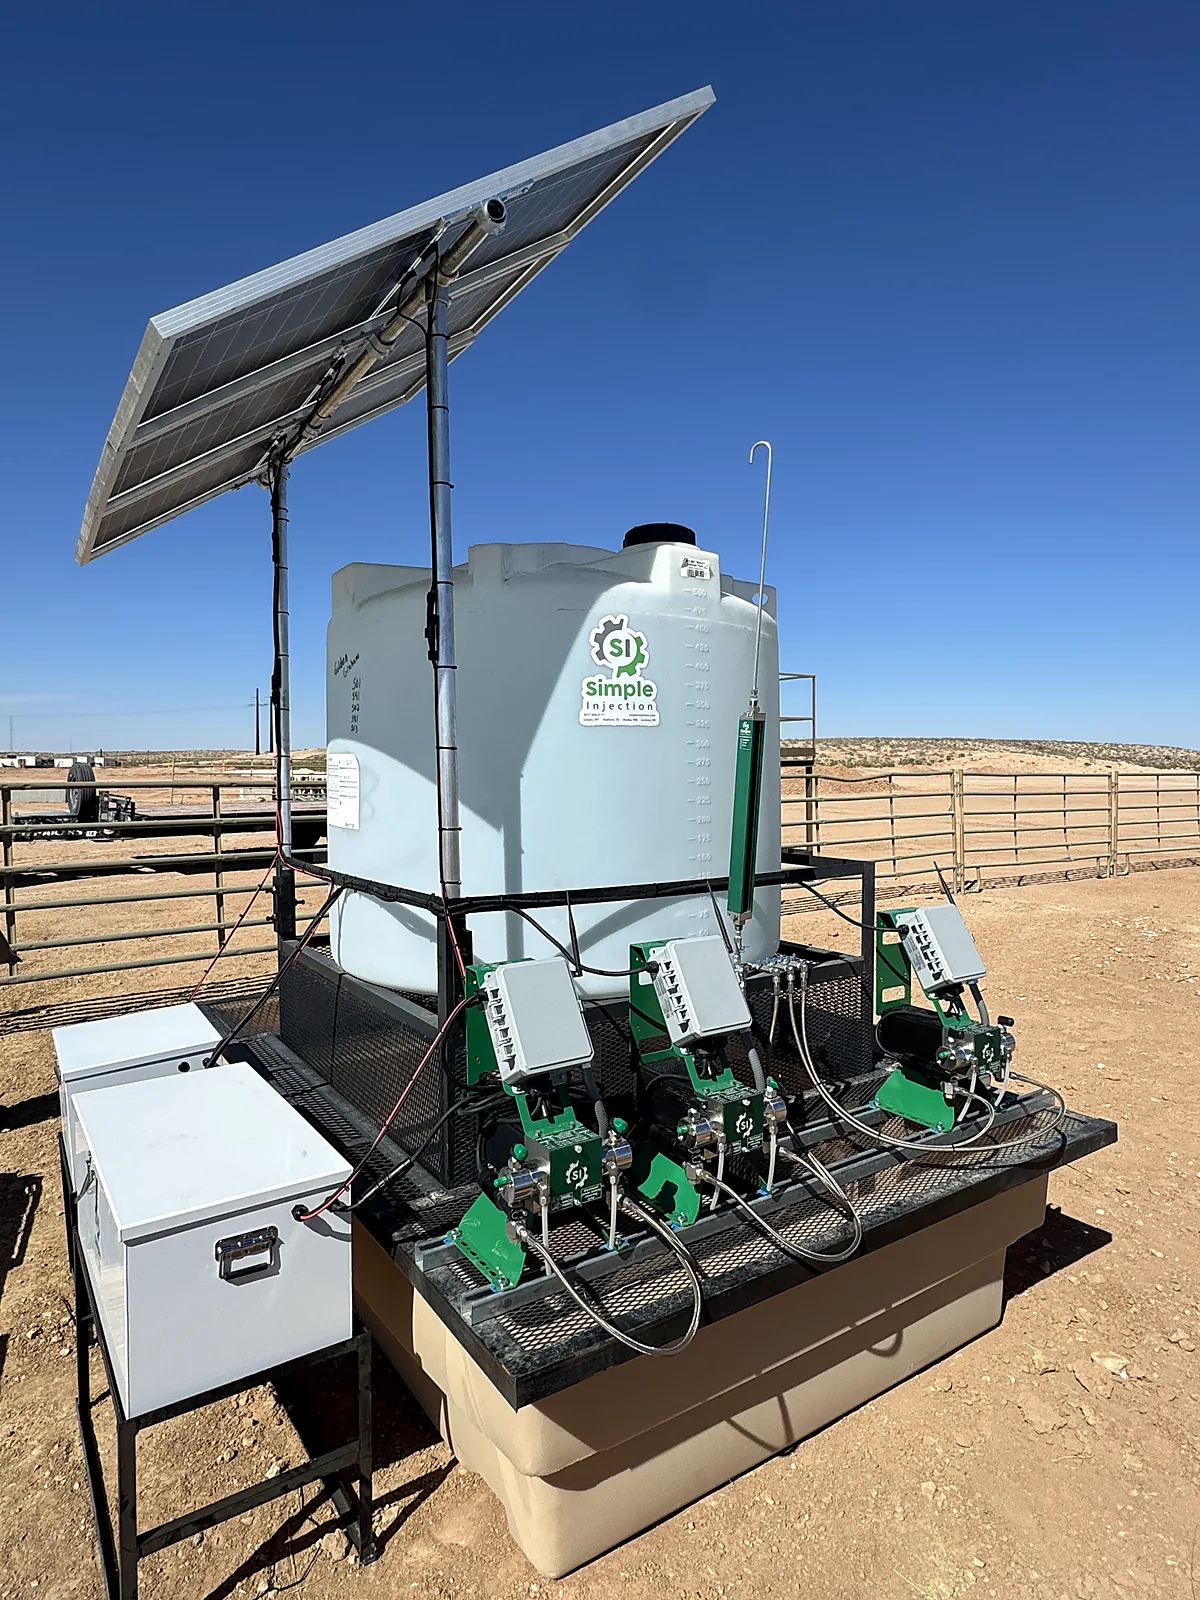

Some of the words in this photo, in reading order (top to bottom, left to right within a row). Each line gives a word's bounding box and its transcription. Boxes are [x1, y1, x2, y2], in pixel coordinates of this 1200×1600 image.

[609, 638, 631, 658] SI
[695, 643, 710, 653] 425
[585, 678, 654, 700] Simple
[586, 701, 654, 712] Injection
[695, 700, 710, 710] 350
[695, 719, 710, 729] 325
[695, 739, 710, 749] 300
[696, 757, 711, 767] 275
[696, 776, 711, 787] 250
[696, 796, 711, 805] 225
[696, 814, 711, 825] 200
[697, 834, 711, 844] 175
[739, 1121, 749, 1131] SI
[571, 1168, 583, 1181] SI
